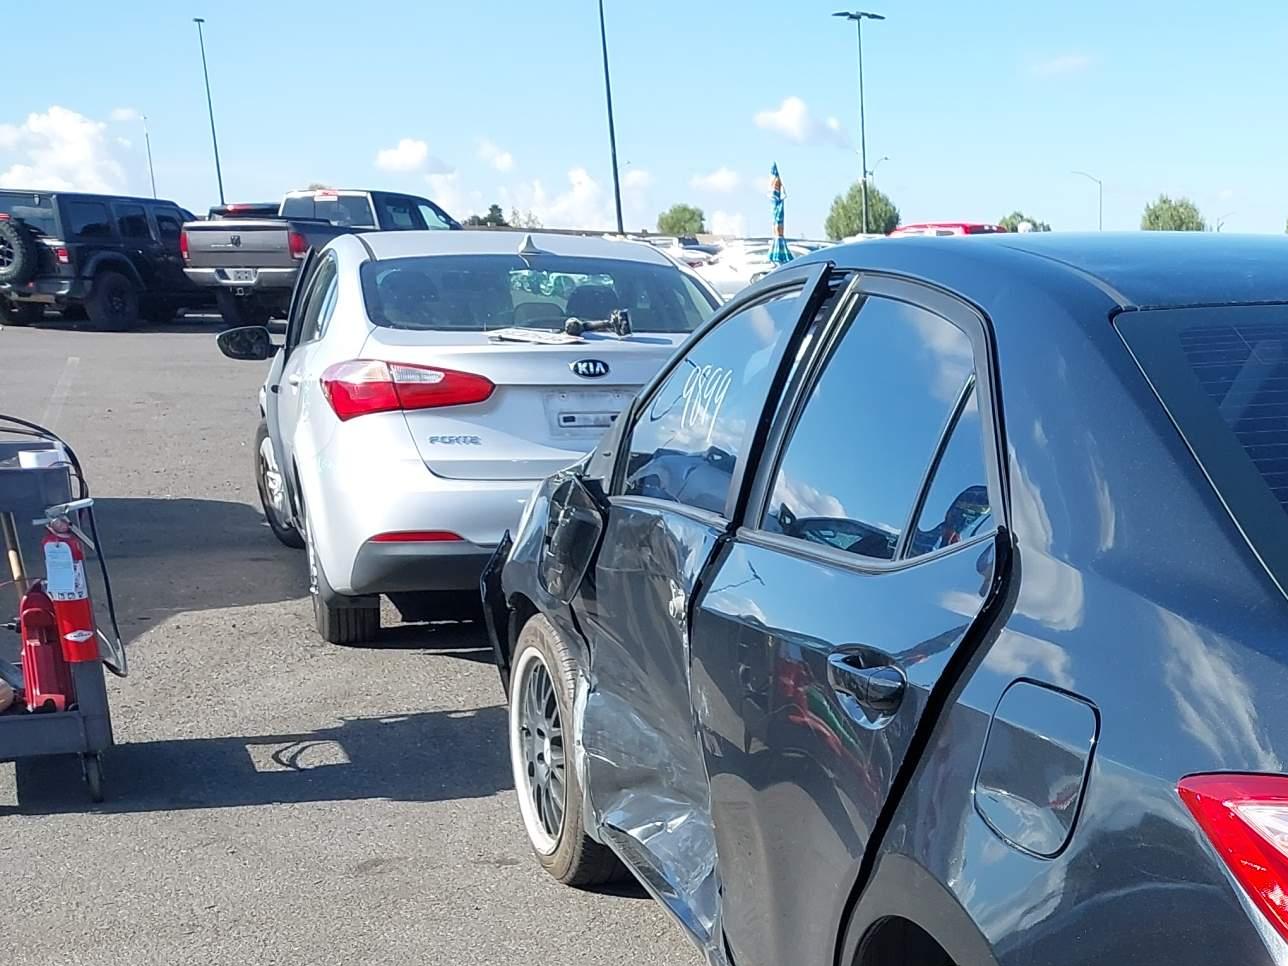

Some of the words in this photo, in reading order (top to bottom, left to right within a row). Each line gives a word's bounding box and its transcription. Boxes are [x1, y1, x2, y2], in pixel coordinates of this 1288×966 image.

[577, 362, 606, 375] KIA
[681, 364, 733, 443] 9899
[429, 435, 482, 446] FORTE
